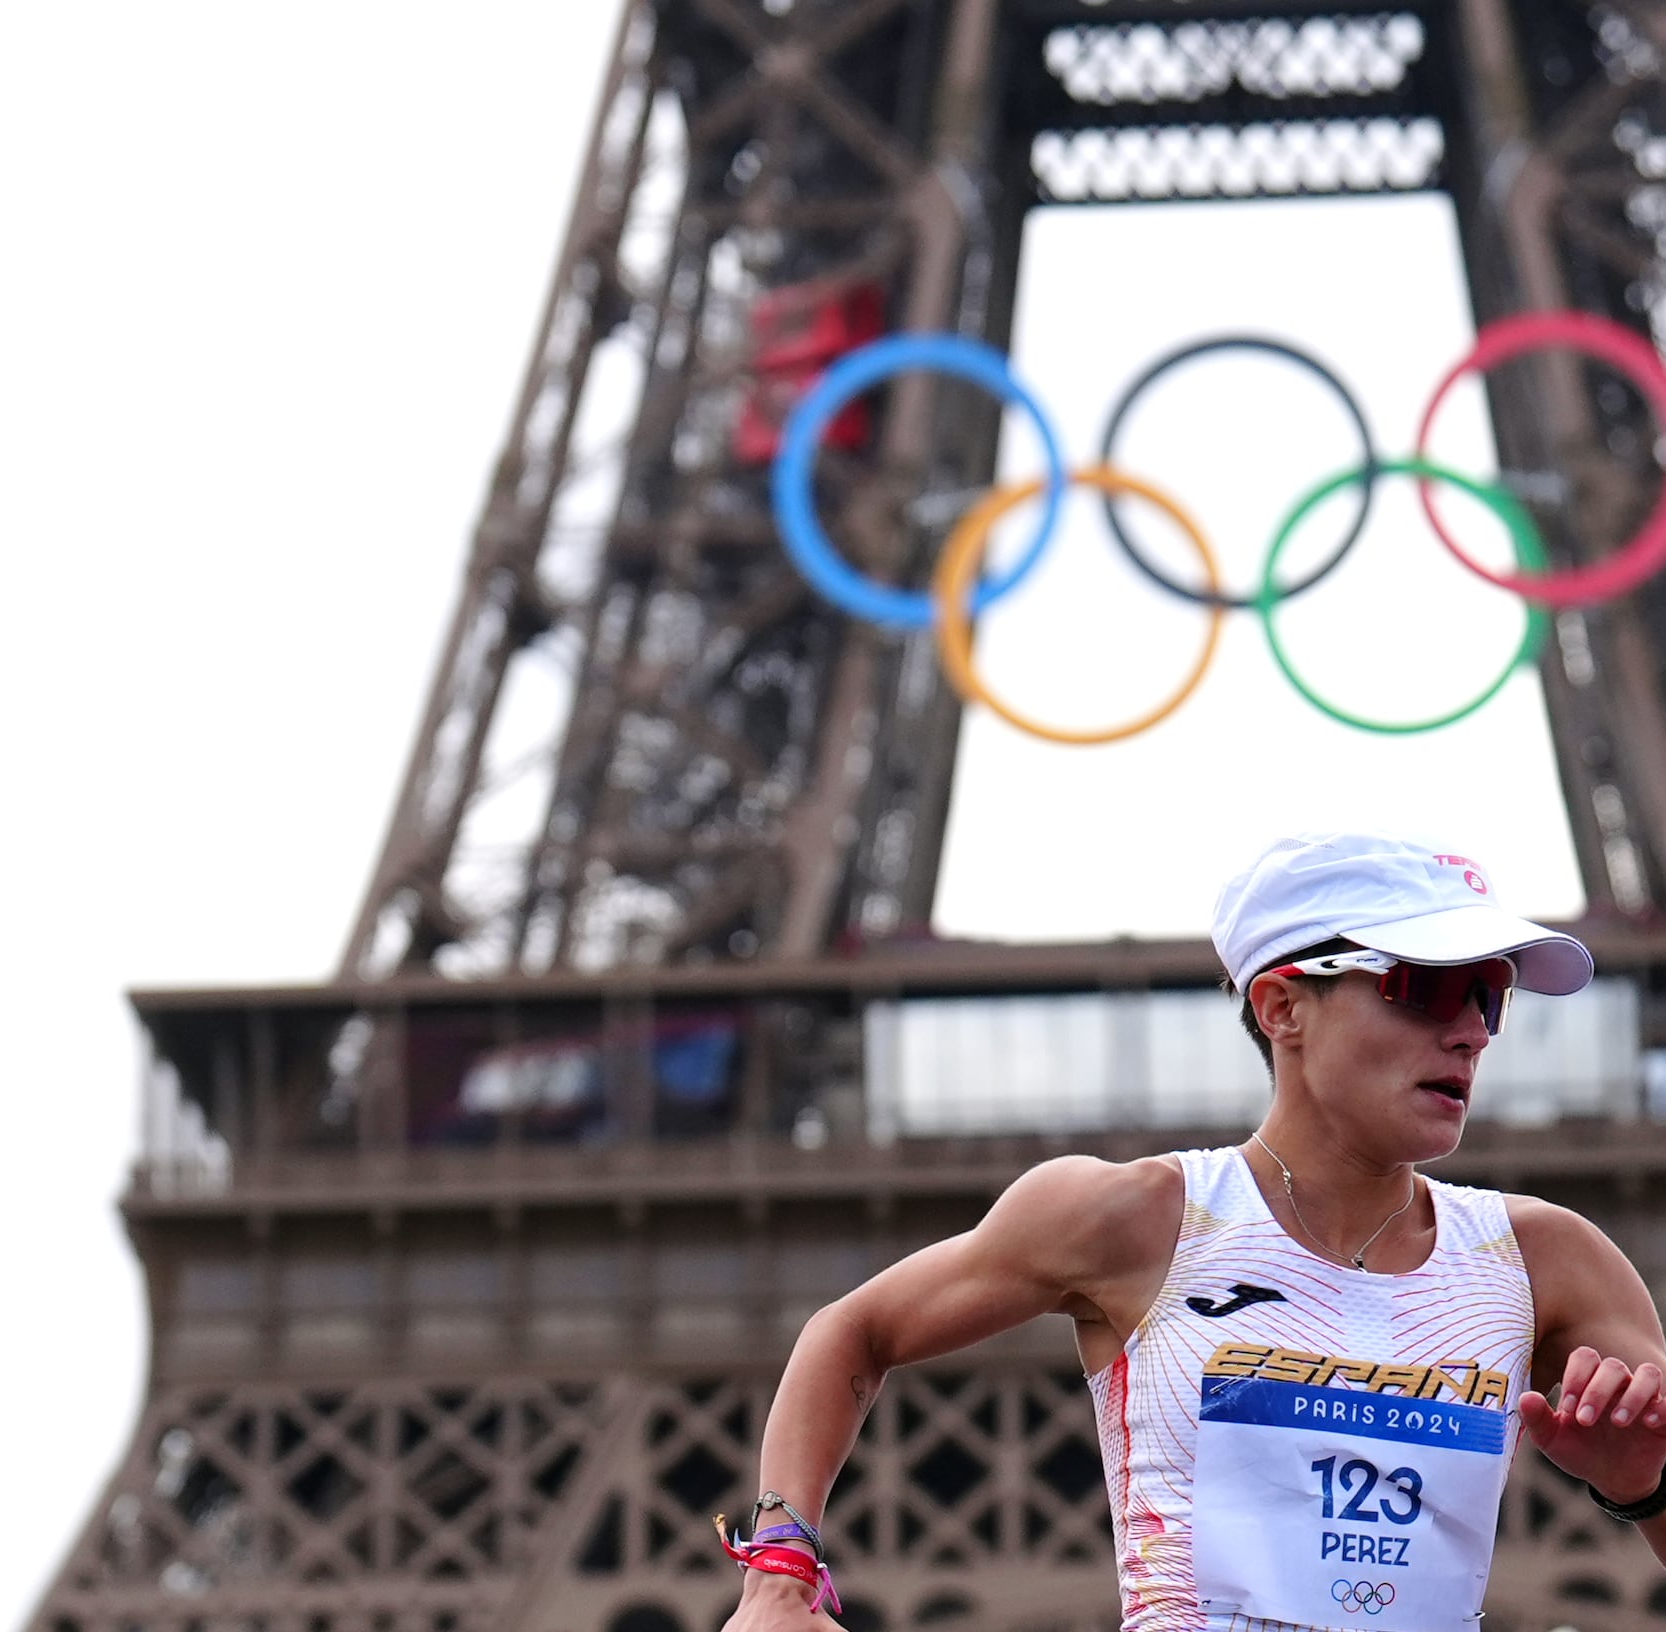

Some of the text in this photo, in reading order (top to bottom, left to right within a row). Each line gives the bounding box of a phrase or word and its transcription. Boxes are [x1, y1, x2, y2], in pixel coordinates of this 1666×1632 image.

[1202, 1340, 1509, 1406] ESPAÑA
[1387, 1411, 1461, 1436] 2024
[1311, 1455, 1423, 1525] 123
[1321, 1531, 1411, 1567] PEREZ
